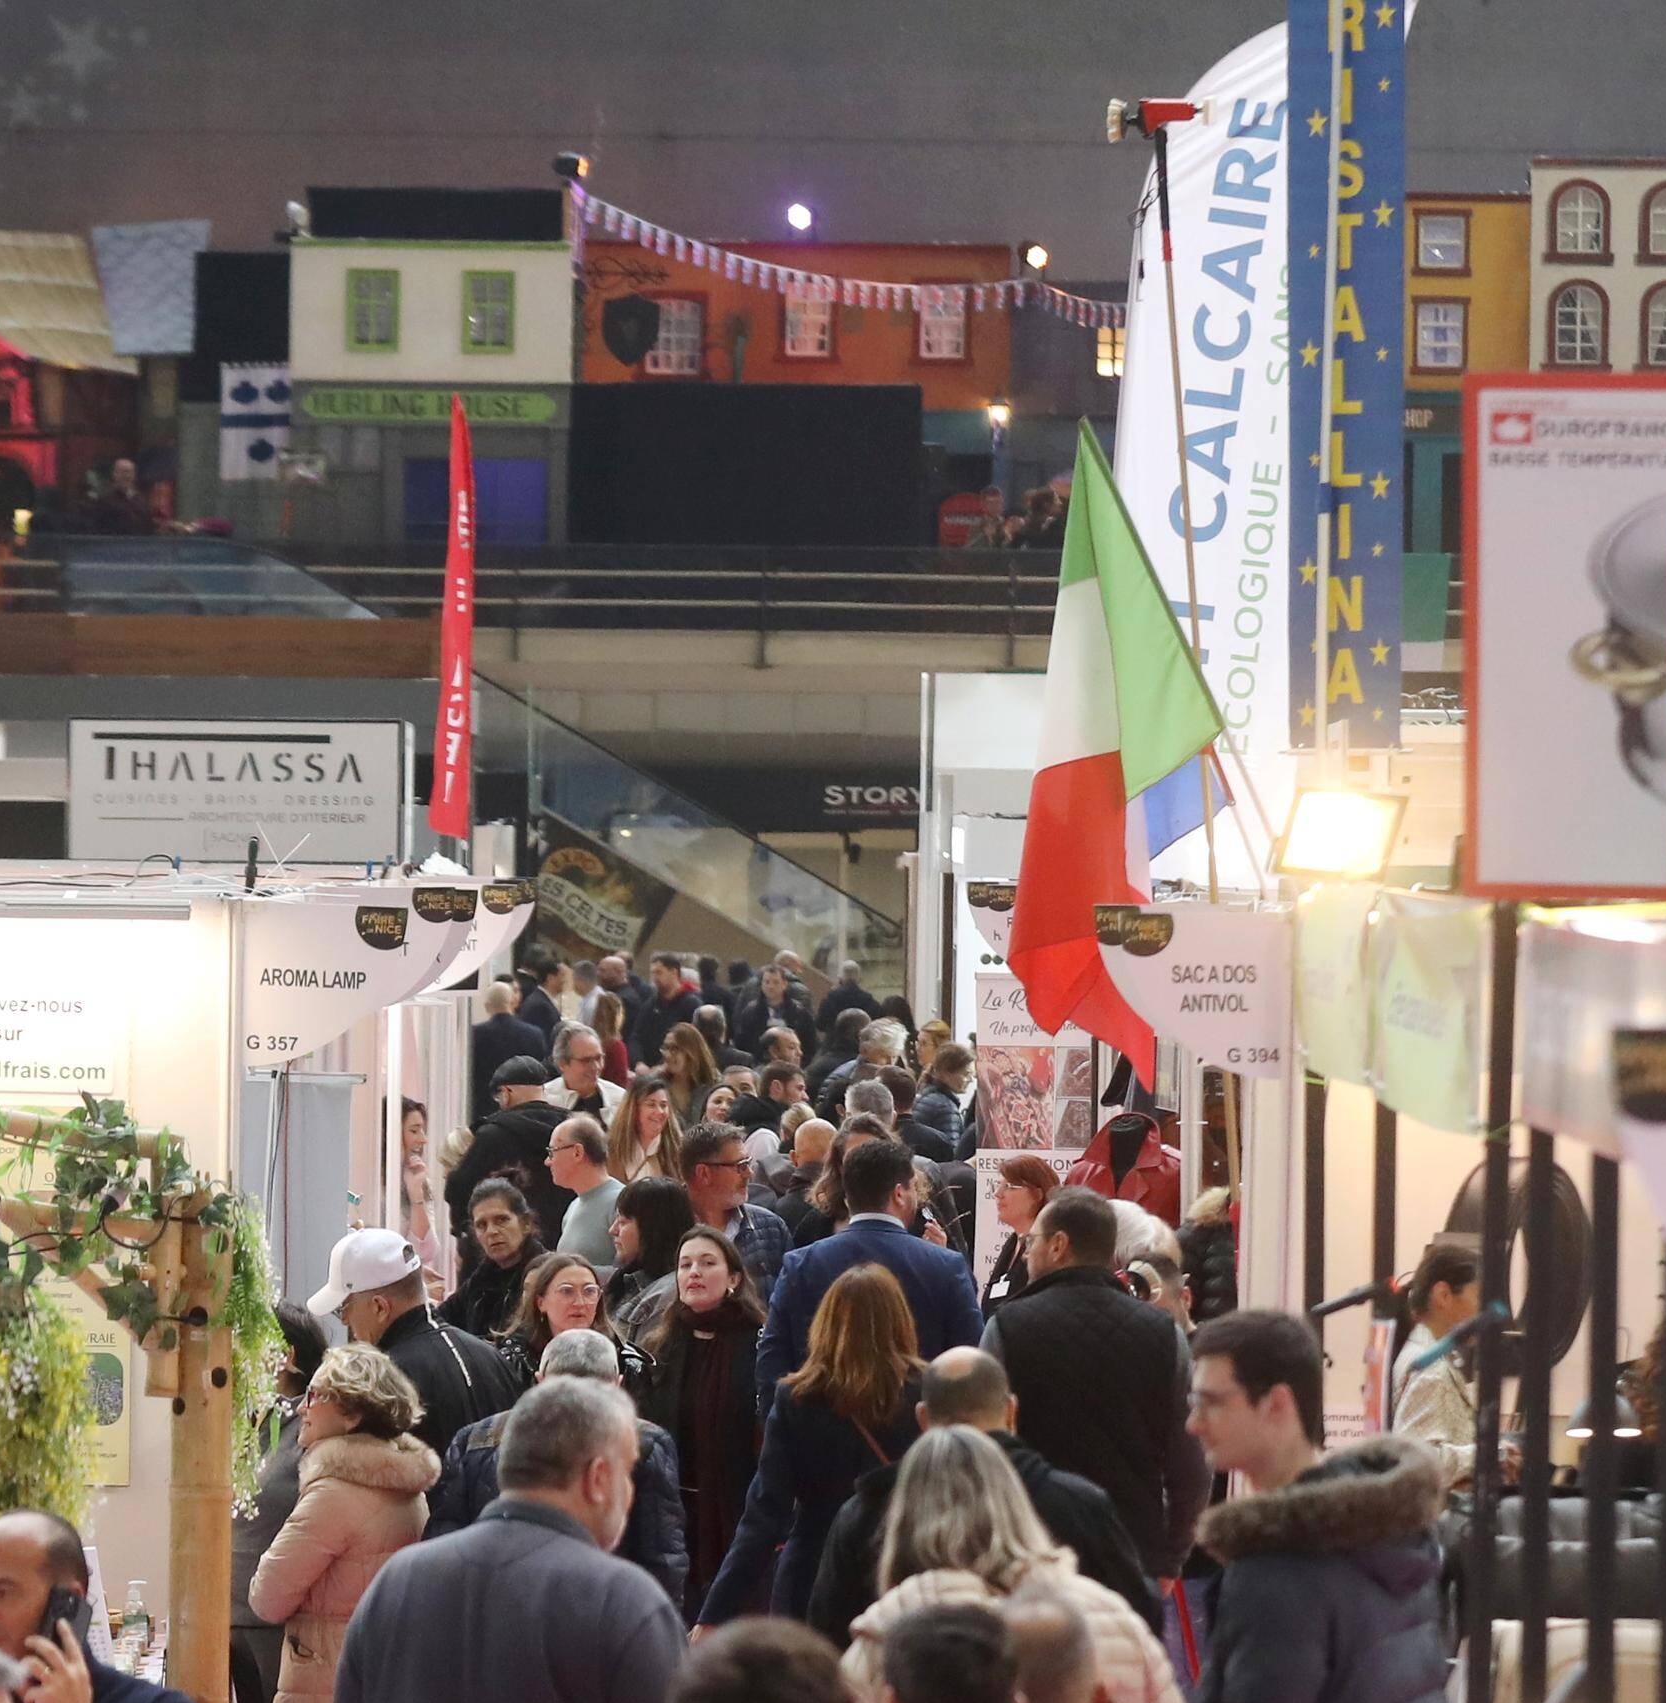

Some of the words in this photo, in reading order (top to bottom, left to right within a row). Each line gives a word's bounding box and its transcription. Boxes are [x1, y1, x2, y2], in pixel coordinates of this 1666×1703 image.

[1168, 97, 1288, 543] CALCAIRE
[436, 393, 528, 420] HUSE
[1403, 408, 1433, 429] HOP
[101, 742, 363, 784] THALASSA
[823, 784, 921, 806] STORY
[374, 924, 404, 936] NICE
[259, 967, 320, 988] AROMA
[322, 969, 367, 991] LAMP
[1171, 965, 1204, 984] SAC
[1207, 965, 1220, 984] A
[1223, 965, 1257, 984] DOS
[1179, 994, 1249, 1013] ANTIVOL
[246, 1034, 261, 1050] G
[266, 1035, 300, 1051] 357
[1226, 1047, 1242, 1064] G
[1246, 1048, 1280, 1064] 394
